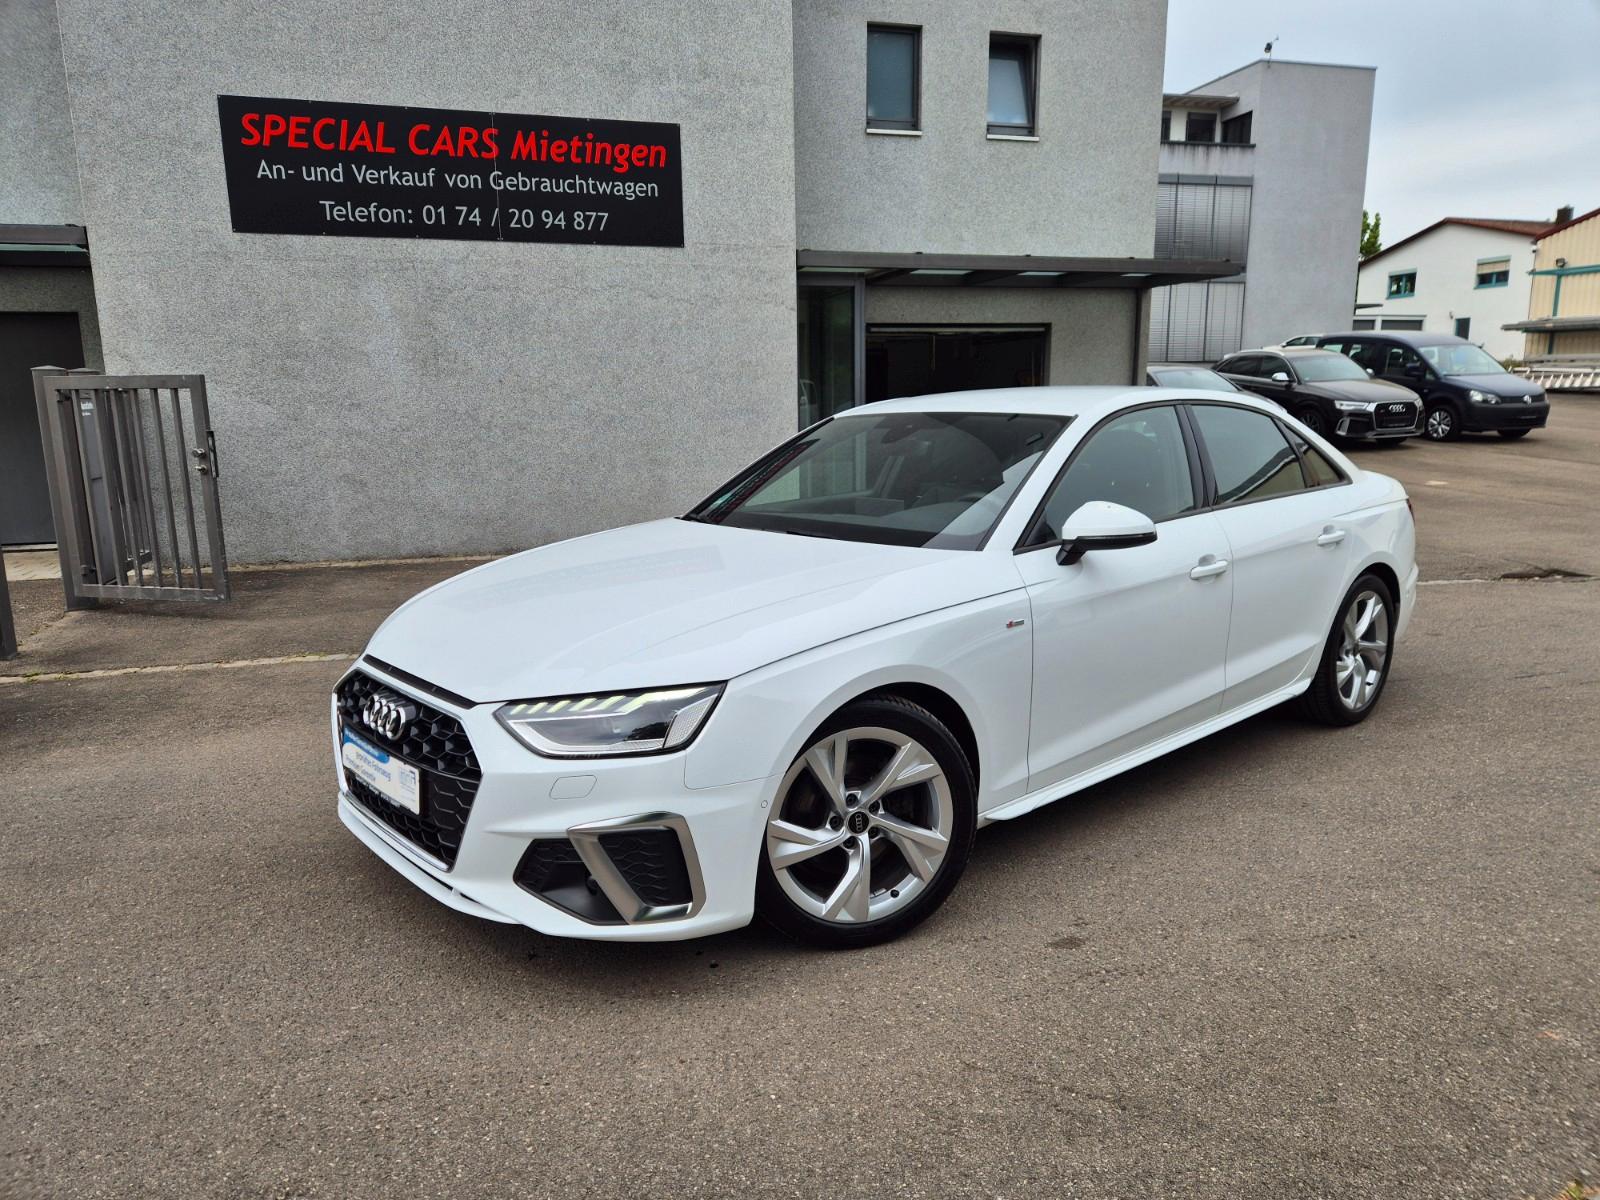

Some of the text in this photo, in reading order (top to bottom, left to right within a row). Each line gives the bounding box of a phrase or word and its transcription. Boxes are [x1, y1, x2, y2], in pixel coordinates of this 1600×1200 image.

[241, 113, 667, 172] SPECIAL CARS Mietingen
[256, 159, 660, 201] An- und Verkauf von Gebrauchtwagen
[319, 200, 609, 232] Telefon: 01 74 / 20 94 877
